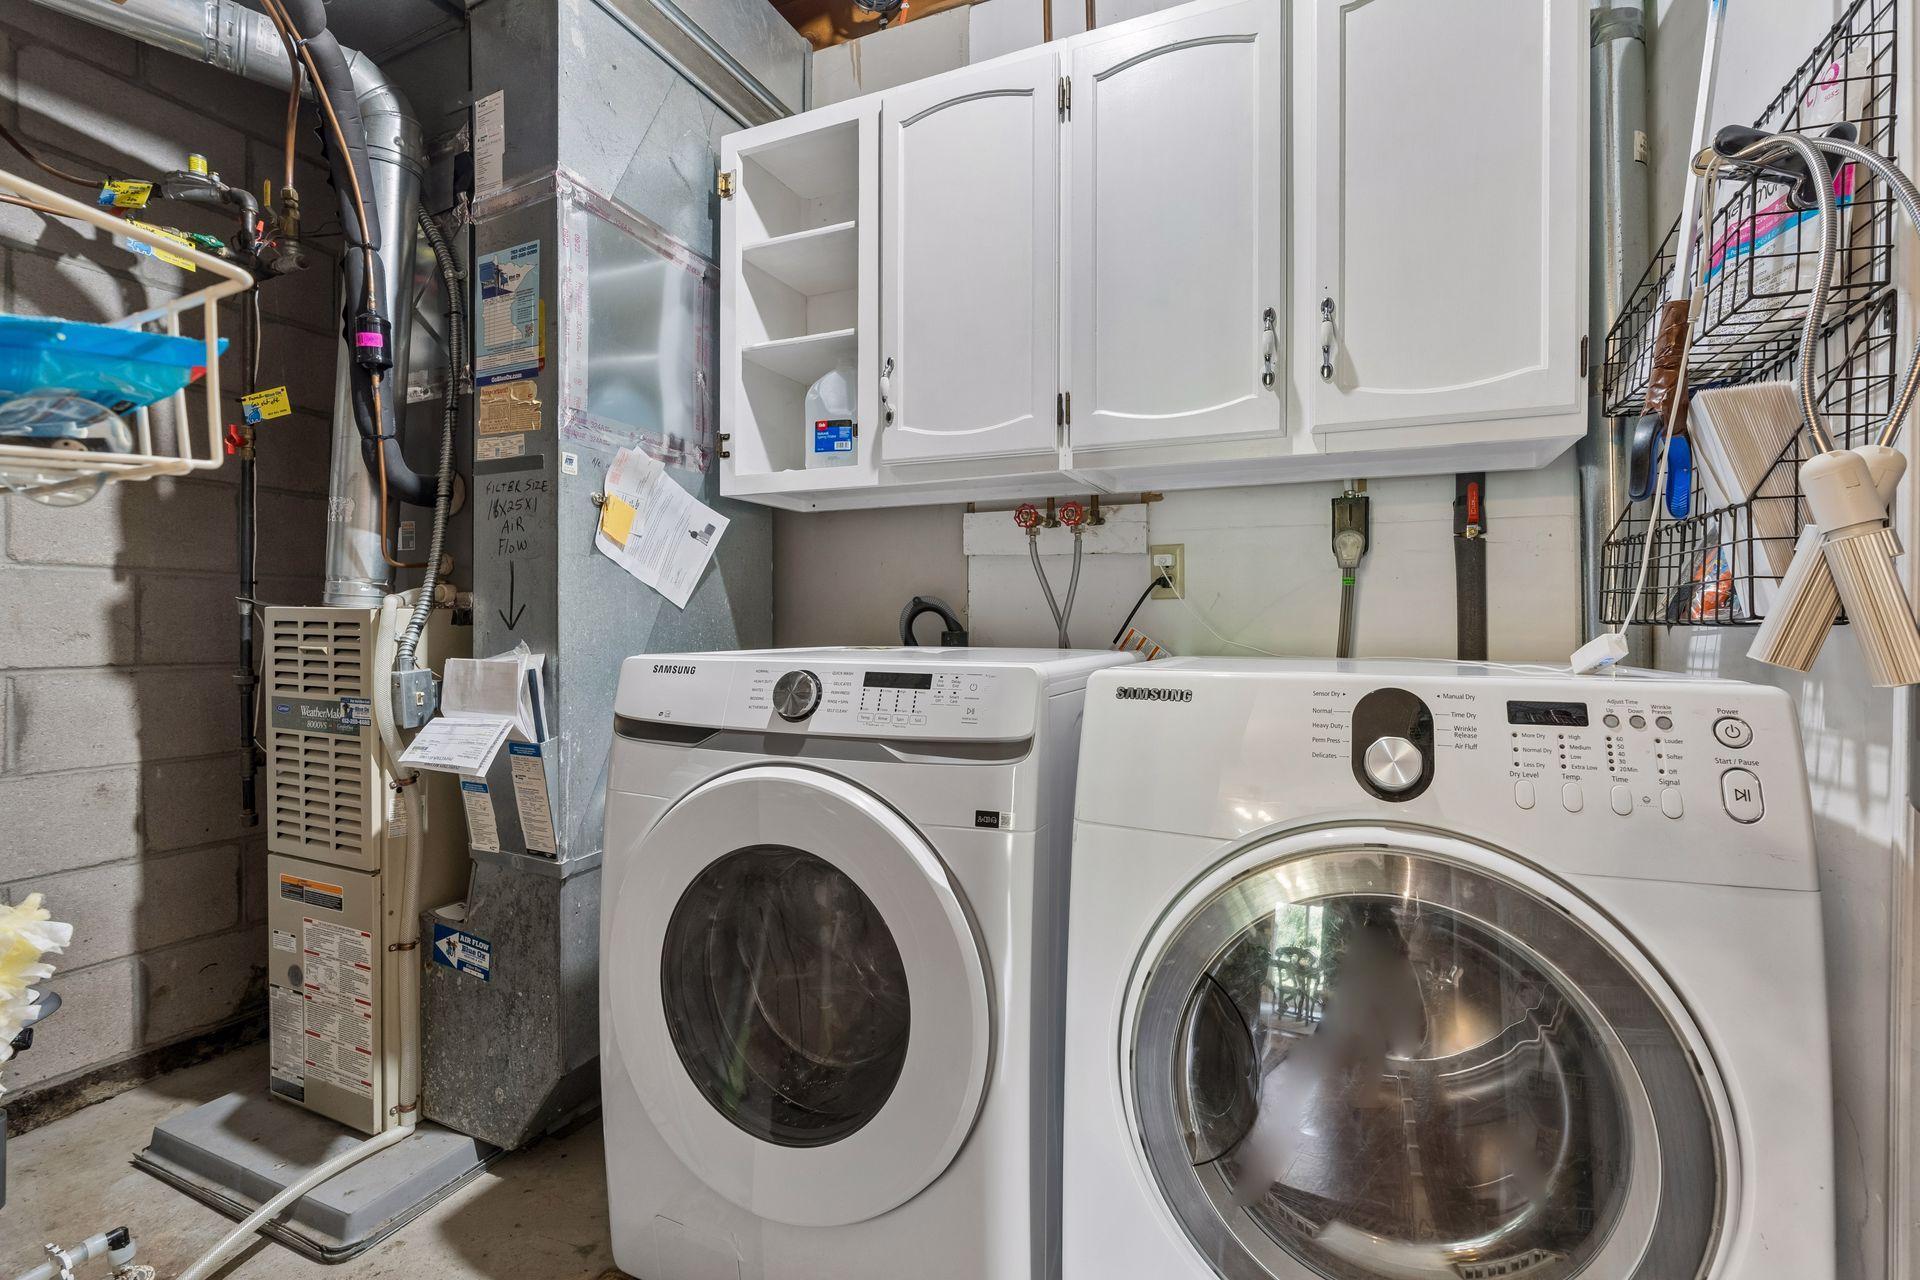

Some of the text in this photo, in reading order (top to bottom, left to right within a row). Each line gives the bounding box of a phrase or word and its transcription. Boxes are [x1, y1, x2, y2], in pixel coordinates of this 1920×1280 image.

[486, 479, 549, 494] FILTER SIZE
[653, 664, 696, 674] SAMSUNG
[1116, 686, 1192, 702] SAMSUNG
[301, 705, 342, 719] WeatherMak
[460, 935, 489, 950] AIR FLOW
[462, 945, 476, 955] Blue
[477, 951, 486, 960] Ox
